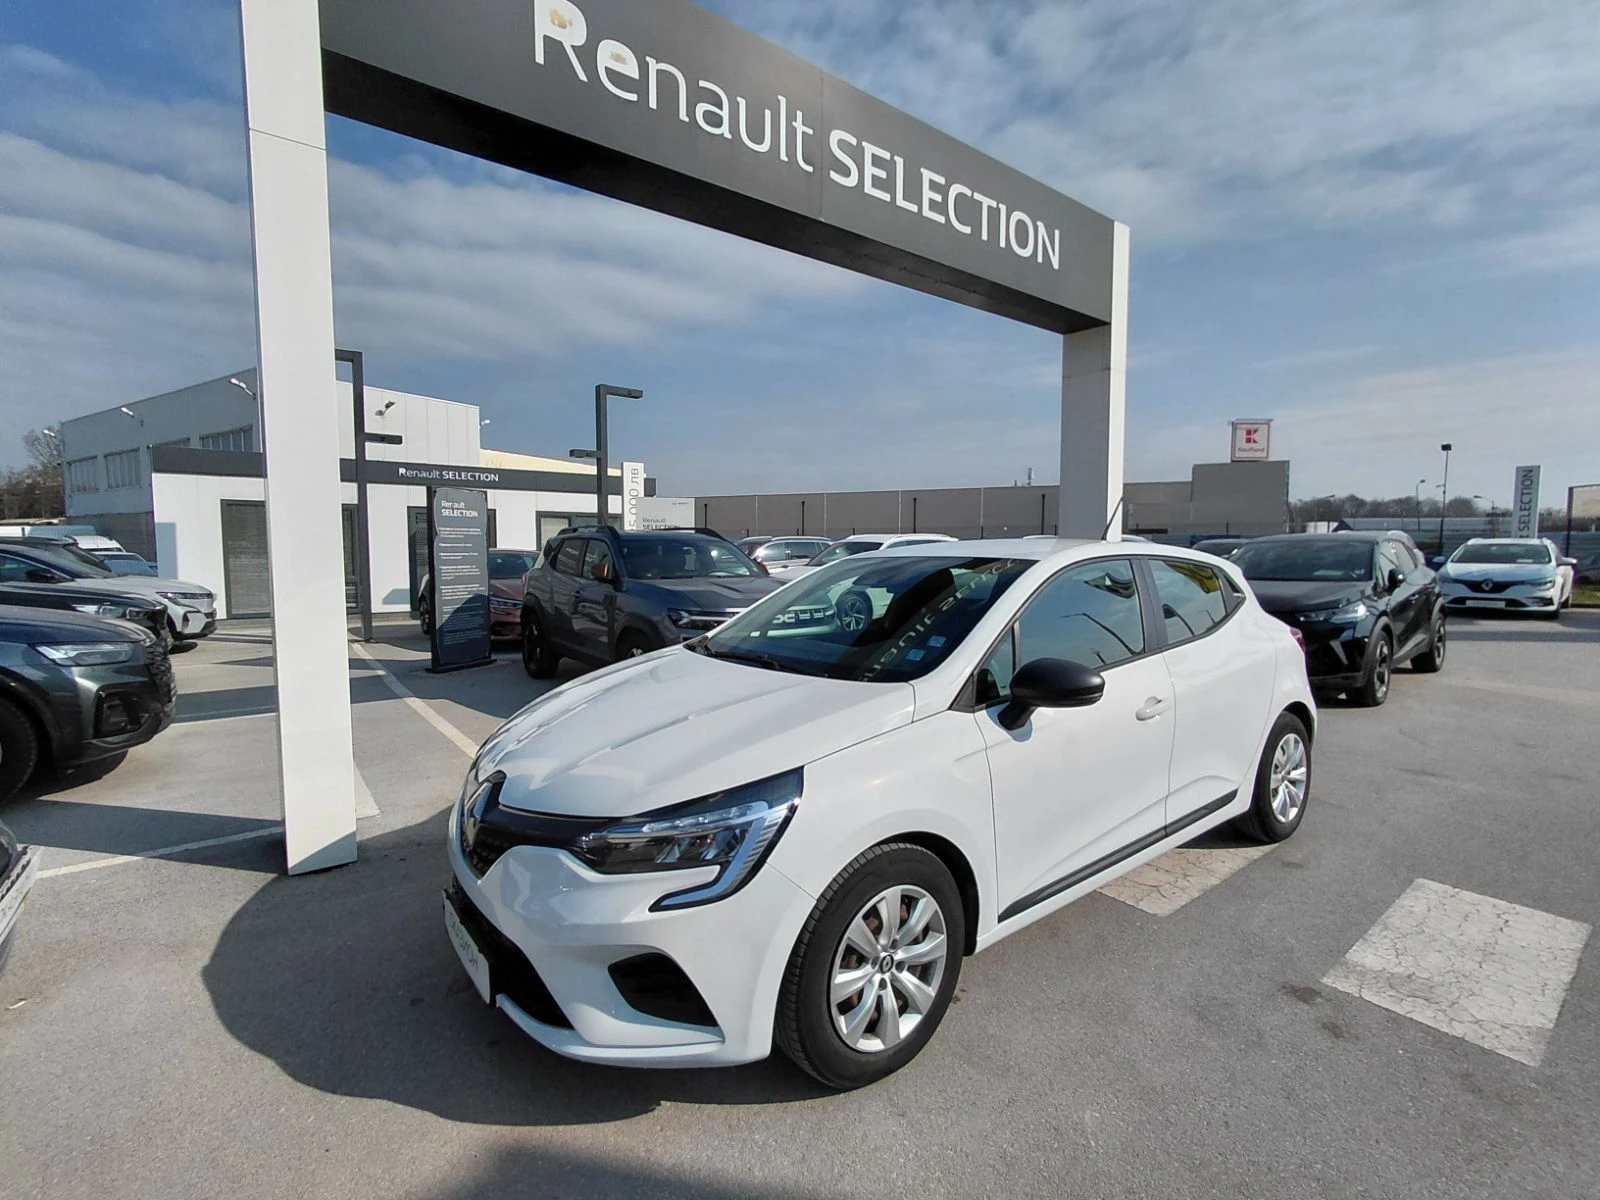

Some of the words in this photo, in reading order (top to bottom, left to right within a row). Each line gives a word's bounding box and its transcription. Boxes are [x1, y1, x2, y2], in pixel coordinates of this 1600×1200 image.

[534, 0, 814, 173] Renault
[829, 129, 1060, 270] SELECTION
[398, 467, 440, 479] Renault
[442, 470, 499, 482] SELECTION
[441, 500, 466, 509] Renault
[1518, 468, 1534, 532] SELECTION
[441, 509, 479, 518] SELECTION
